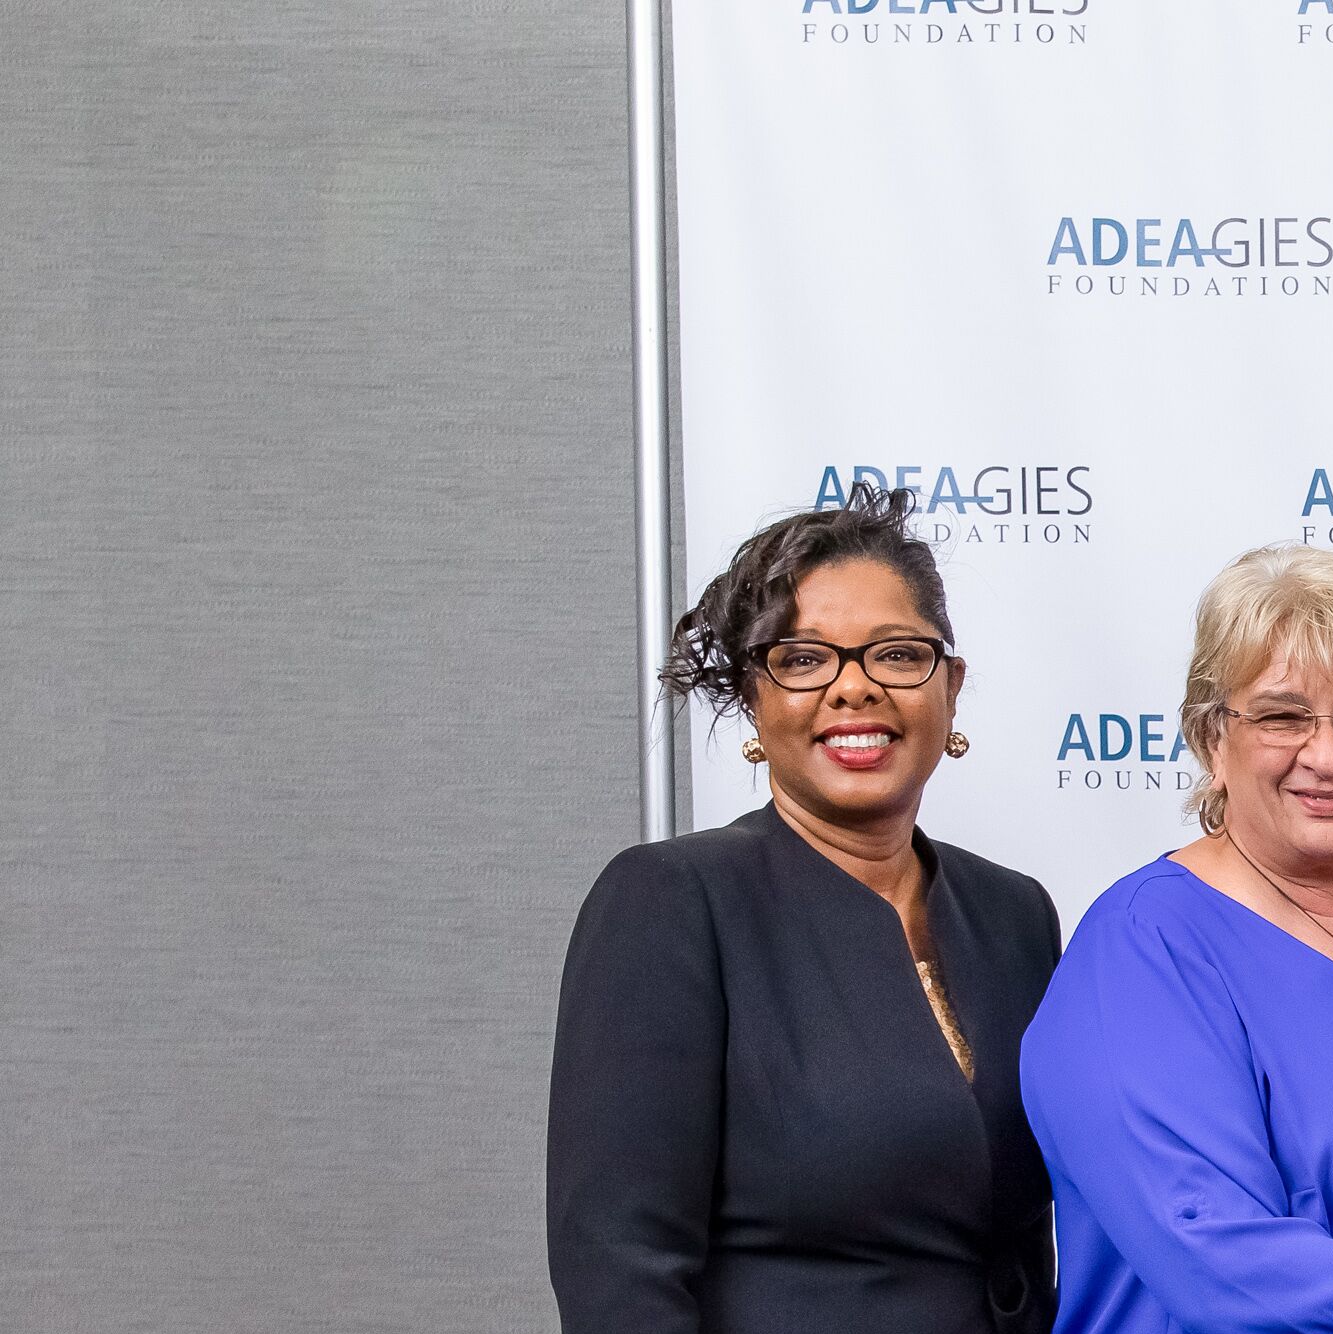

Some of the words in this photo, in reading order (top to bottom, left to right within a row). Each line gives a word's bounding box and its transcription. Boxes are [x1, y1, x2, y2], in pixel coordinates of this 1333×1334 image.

[803, 24, 1086, 44] FOUNDATION
[1048, 275, 1331, 296] FOUNDATION
[915, 524, 1091, 544] DATION
[1057, 770, 1193, 790] FOUND
